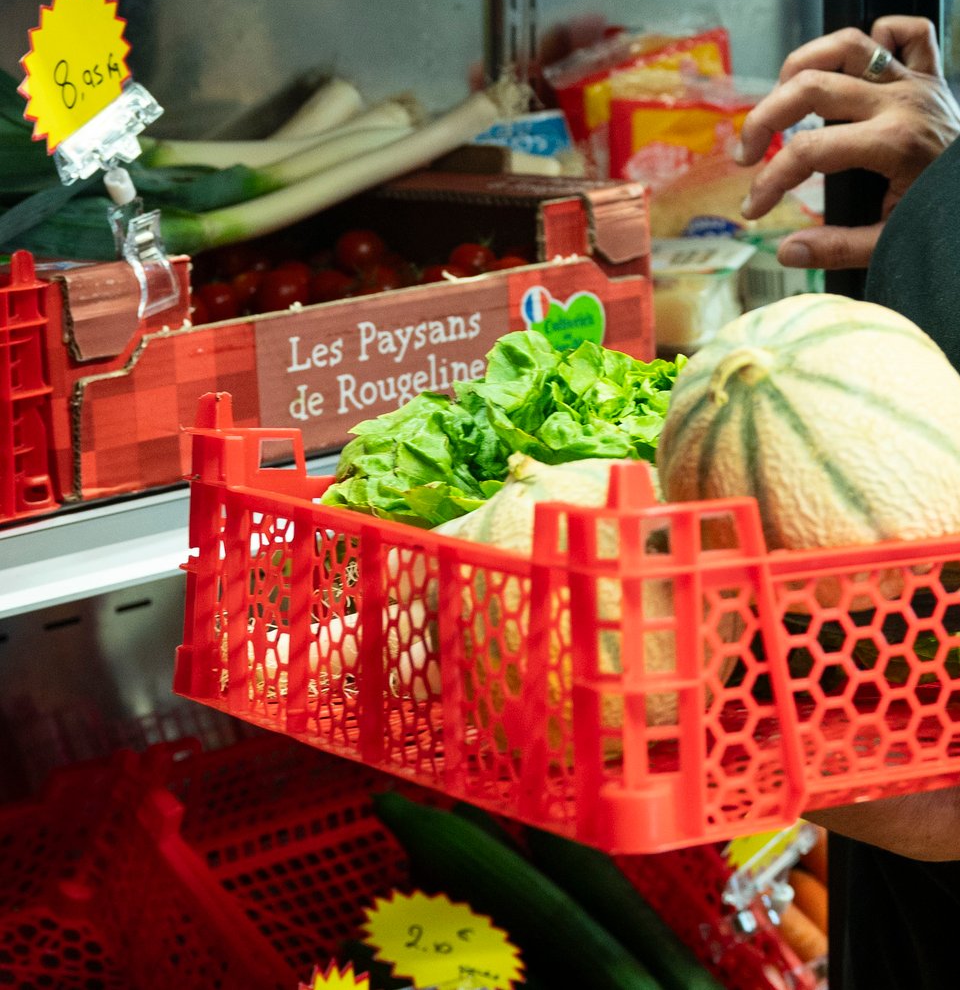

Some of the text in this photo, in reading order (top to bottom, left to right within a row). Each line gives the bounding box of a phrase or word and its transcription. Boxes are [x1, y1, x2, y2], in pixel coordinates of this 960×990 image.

[287, 312, 481, 373] Les Paysans
[289, 353, 486, 421] de Rougeline
